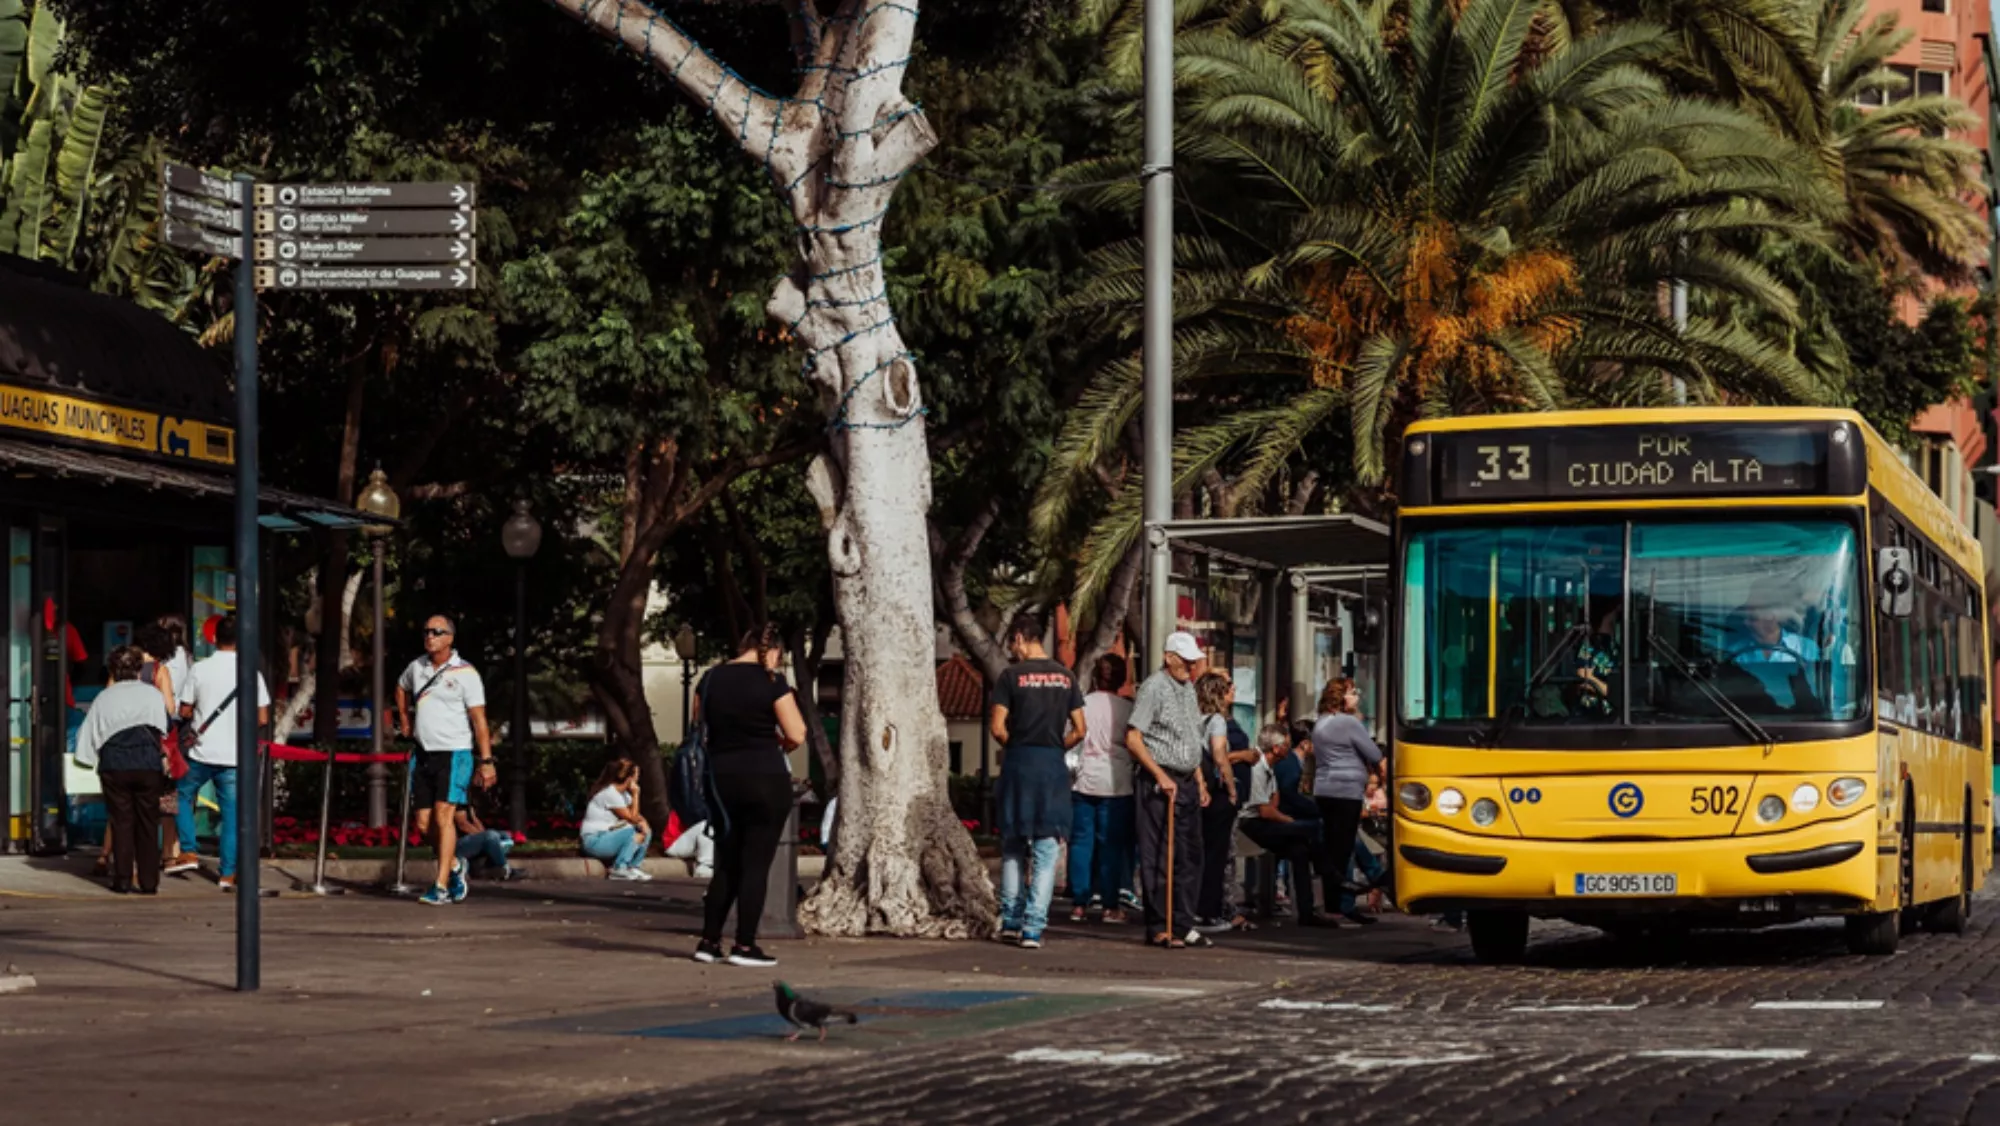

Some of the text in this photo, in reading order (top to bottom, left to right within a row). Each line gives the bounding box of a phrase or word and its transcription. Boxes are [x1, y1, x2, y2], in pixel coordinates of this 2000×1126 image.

[300, 185, 345, 196] Estación
[300, 213, 369, 223] Edificio Miller
[300, 241, 364, 251] Museo Elder
[301, 268, 441, 281] Intercambiador de Guaguas
[64, 403, 146, 442] MUNICIPALES
[1638, 435, 1692, 457] POR
[1477, 445, 1531, 481] 33
[1568, 458, 1763, 487] CIUDAD ALTA
[1690, 785, 1739, 815] 502
